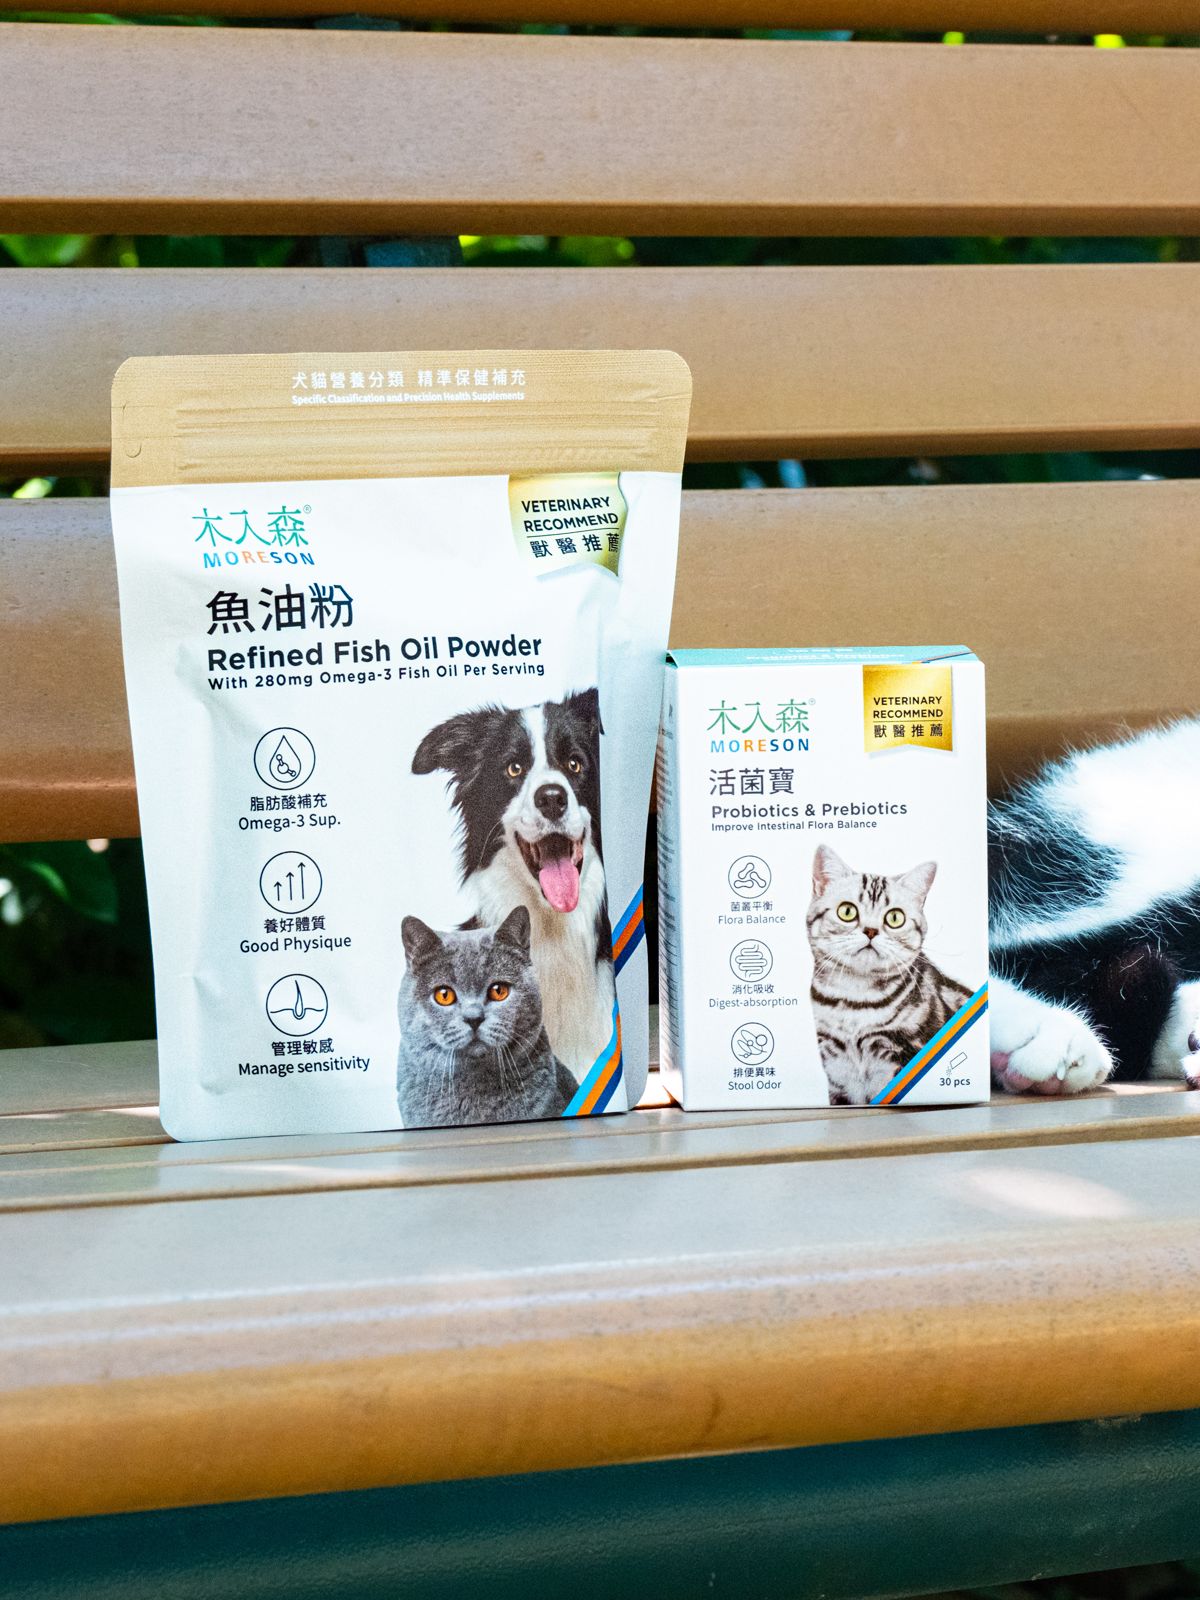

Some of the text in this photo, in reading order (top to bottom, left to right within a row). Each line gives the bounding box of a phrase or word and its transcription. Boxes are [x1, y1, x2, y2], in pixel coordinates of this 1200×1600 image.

[292, 368, 526, 389] 犬貓營養分類 精準保健補充
[292, 391, 525, 405] Specific Classification and Precision Health Supplements
[521, 496, 610, 513] VETERINARY
[523, 512, 619, 532] RECOMMEND
[530, 533, 619, 558] 獸醫推薦
[203, 550, 316, 569] MORESON
[206, 582, 354, 635] 魚油粉
[208, 633, 542, 671] Refined Fish Oil Powder
[208, 661, 545, 690] With 280mg Omega-3 Fish Oil Per Serving
[873, 696, 942, 705] VETERINARY
[873, 709, 943, 718] RECOMMEND
[873, 723, 943, 738] 獸醫推薦
[710, 738, 809, 753] MORESON
[709, 767, 795, 796] 活菌寶
[249, 793, 328, 812] 脂肪酸補充
[711, 802, 907, 819] Probiotics & Prebiotics
[238, 812, 341, 831] Omega-3 Sup.
[711, 819, 877, 833] Improve Intestinal Flora Balance
[263, 915, 326, 934] 養好體質
[718, 914, 786, 925] Flora Balance
[239, 934, 352, 953] Good Physique
[732, 984, 775, 995] 消化吸收
[709, 996, 798, 1009] Digest-absorption
[271, 1038, 334, 1057] 管理敏感
[238, 1055, 370, 1077] Manage sensitivity
[733, 1067, 776, 1078] 排便異味
[728, 1080, 782, 1090] Stool Odor
[939, 1077, 971, 1090] 30 pcs
